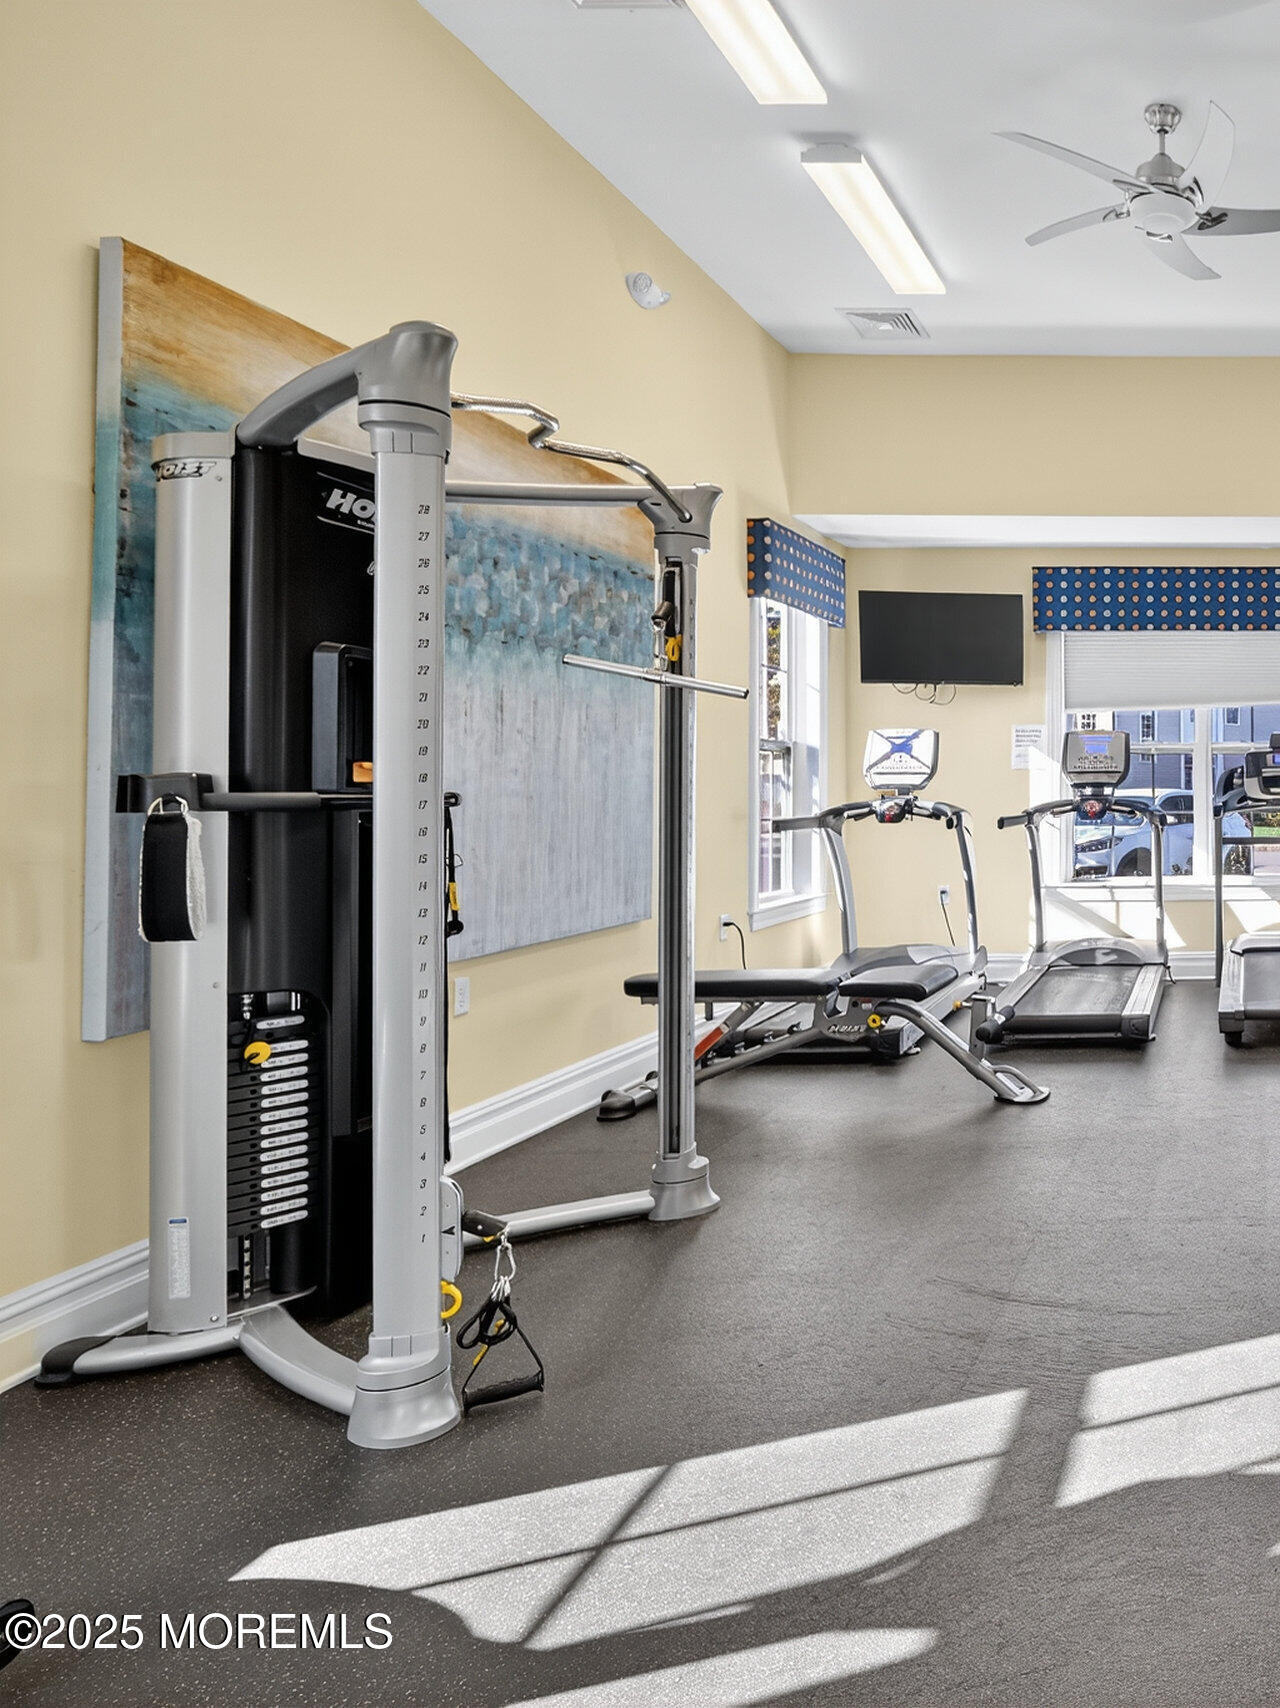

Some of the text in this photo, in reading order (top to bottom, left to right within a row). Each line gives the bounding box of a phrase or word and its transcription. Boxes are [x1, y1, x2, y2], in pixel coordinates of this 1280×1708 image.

[417, 504, 431, 515] 28
[417, 531, 430, 542] 27
[417, 584, 430, 595] 25
[417, 611, 430, 622] 24
[417, 638, 430, 649] 23
[416, 664, 430, 676] 22
[417, 691, 430, 703] 21
[416, 718, 431, 730] 20
[417, 772, 429, 784] 18
[416, 799, 429, 812] 17
[417, 853, 429, 865] 15
[417, 880, 429, 892] 14
[417, 907, 429, 918] 13
[417, 934, 429, 946] 12
[418, 961, 428, 973] 11
[417, 988, 430, 1000] 10
